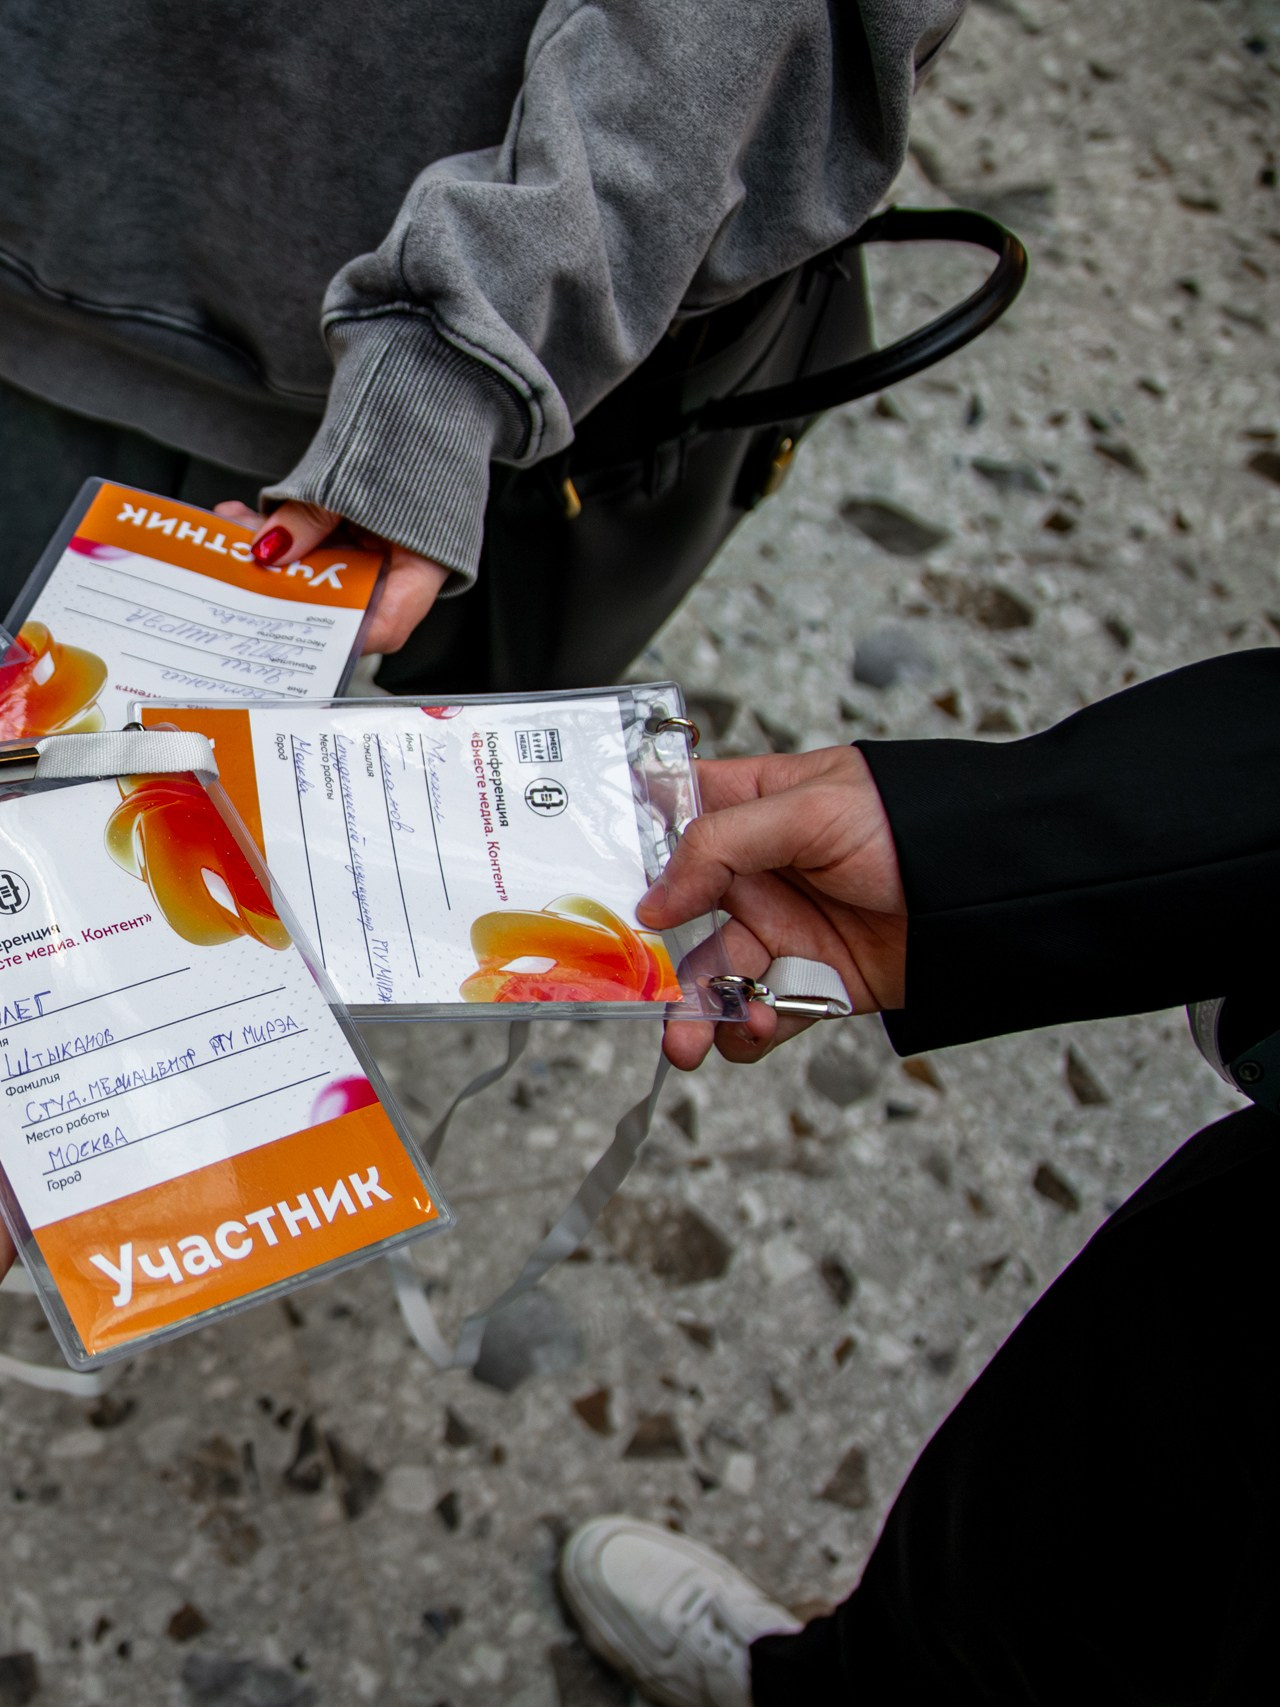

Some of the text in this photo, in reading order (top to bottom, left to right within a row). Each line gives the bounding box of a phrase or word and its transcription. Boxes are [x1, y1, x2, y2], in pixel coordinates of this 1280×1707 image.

[114, 501, 347, 589] Учстник
[275, 732, 288, 760] Город
[361, 733, 375, 777] Фамилия
[404, 732, 414, 752] Имя
[517, 734, 528, 759] МЕДИА
[548, 731, 558, 759] ВМЕСТЕ
[318, 733, 335, 800] Место работы
[484, 731, 510, 827] Конференция
[469, 731, 509, 902] «Вместе медиа. Контент»
[24, 935, 80, 961] медиа.
[80, 912, 154, 942] Контент»
[240, 1013, 299, 1048] МИРЭА
[4, 1072, 61, 1097] Фамилия
[24, 1106, 111, 1144] Место работы
[45, 1125, 129, 1171] МОСКВА
[45, 1169, 84, 1191] Город
[87, 1164, 393, 1308] Участник
